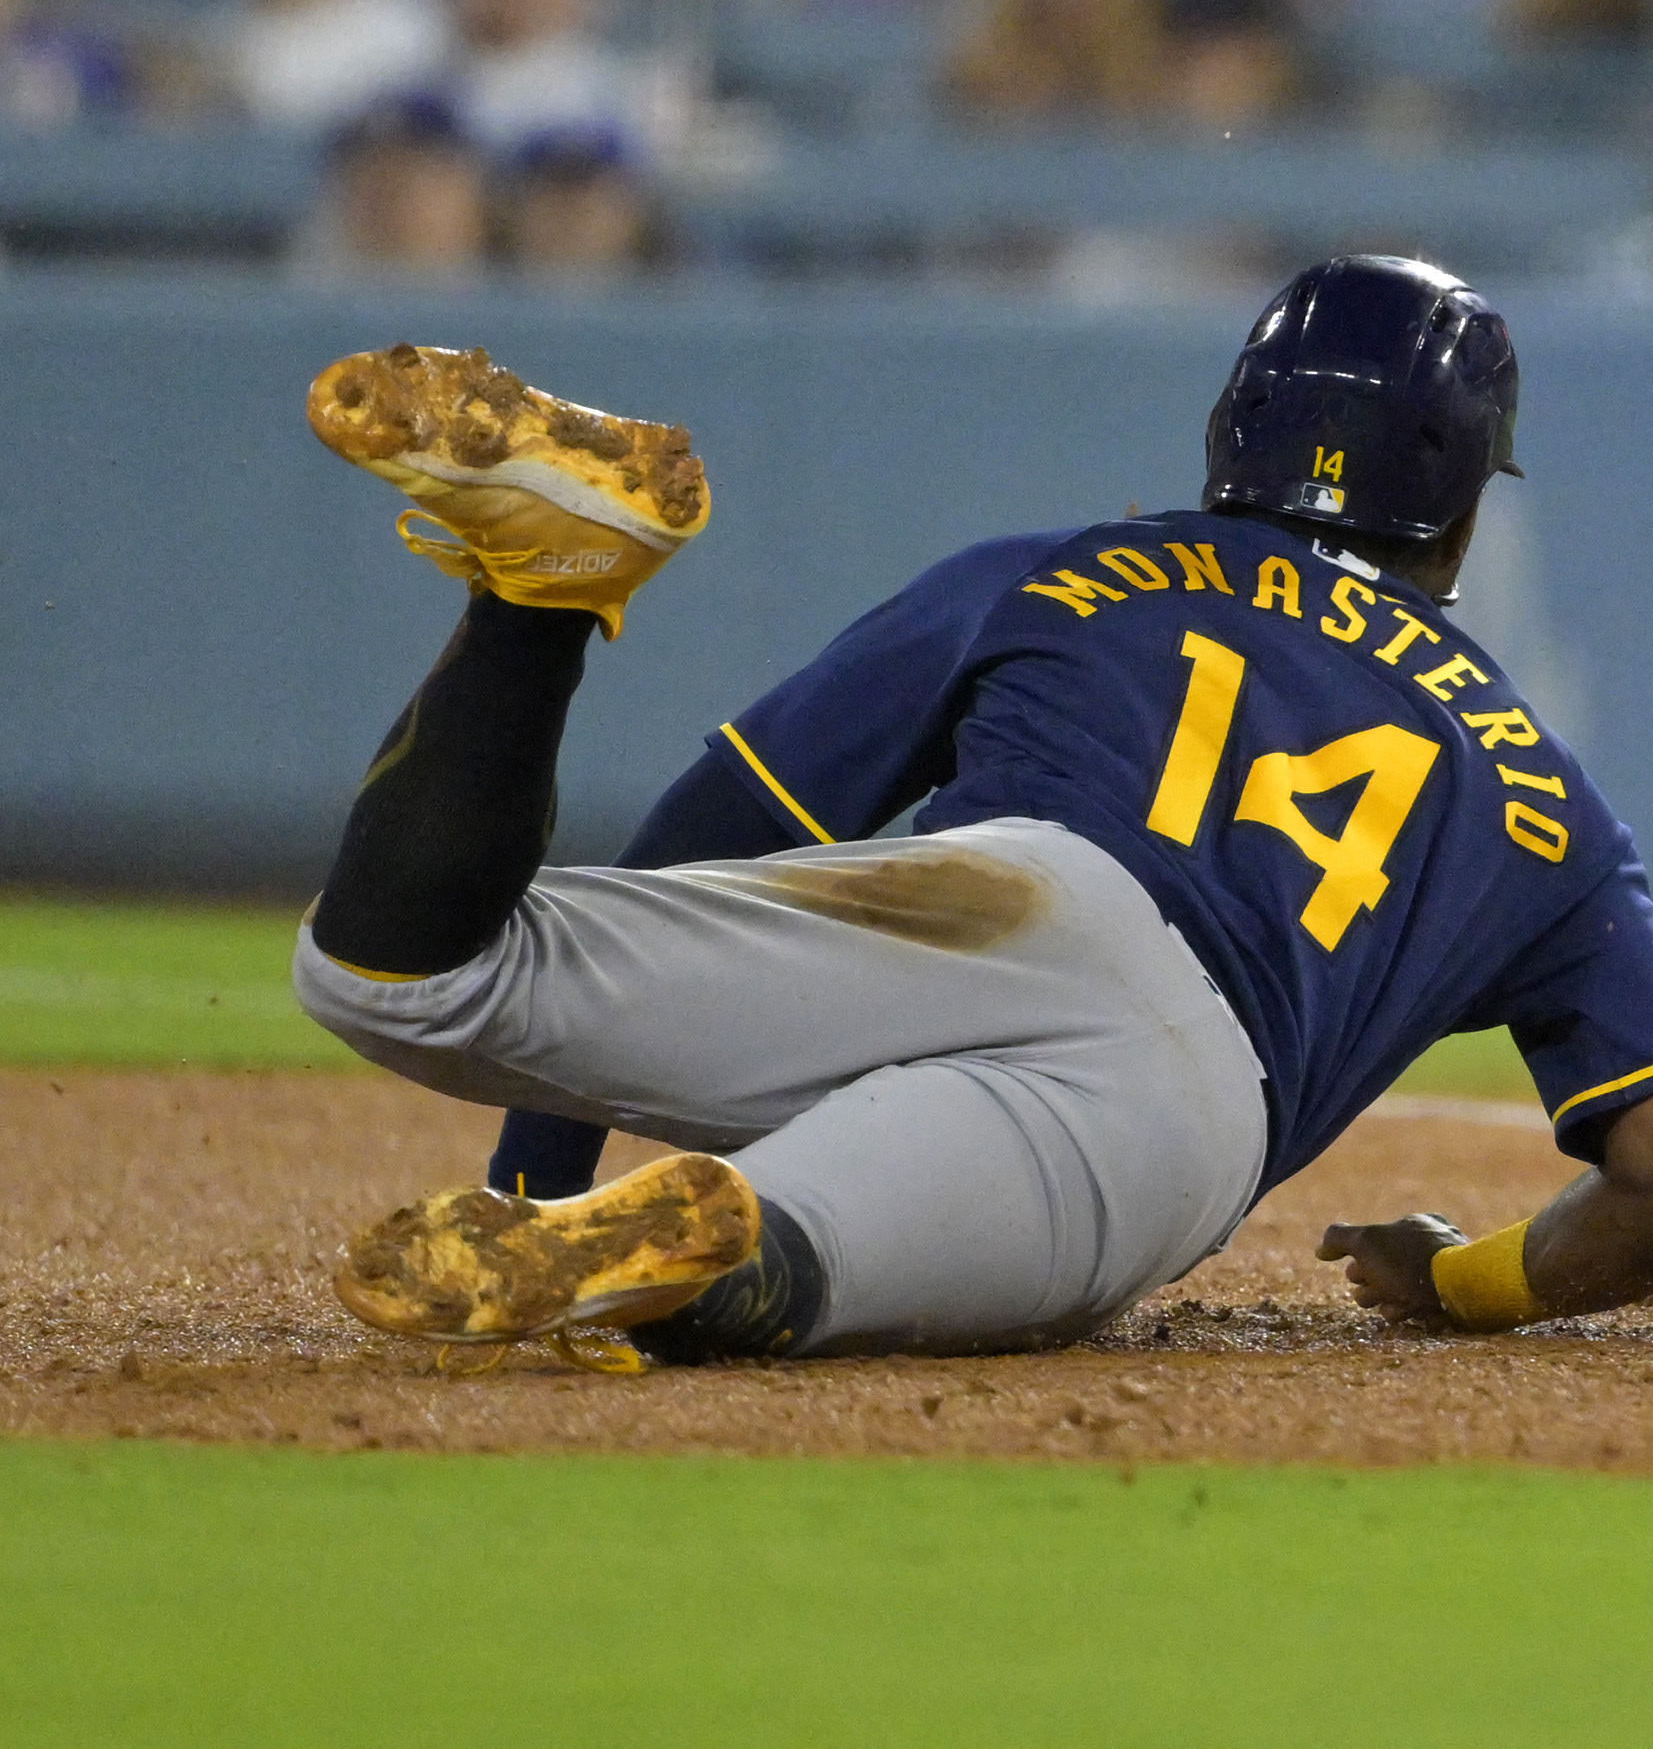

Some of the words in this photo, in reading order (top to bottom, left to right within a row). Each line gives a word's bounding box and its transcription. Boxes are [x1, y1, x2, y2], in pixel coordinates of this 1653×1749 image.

[1313, 446, 1345, 482] 14
[1021, 541, 1571, 863] MONASTERIO
[1146, 631, 1441, 952] 14
